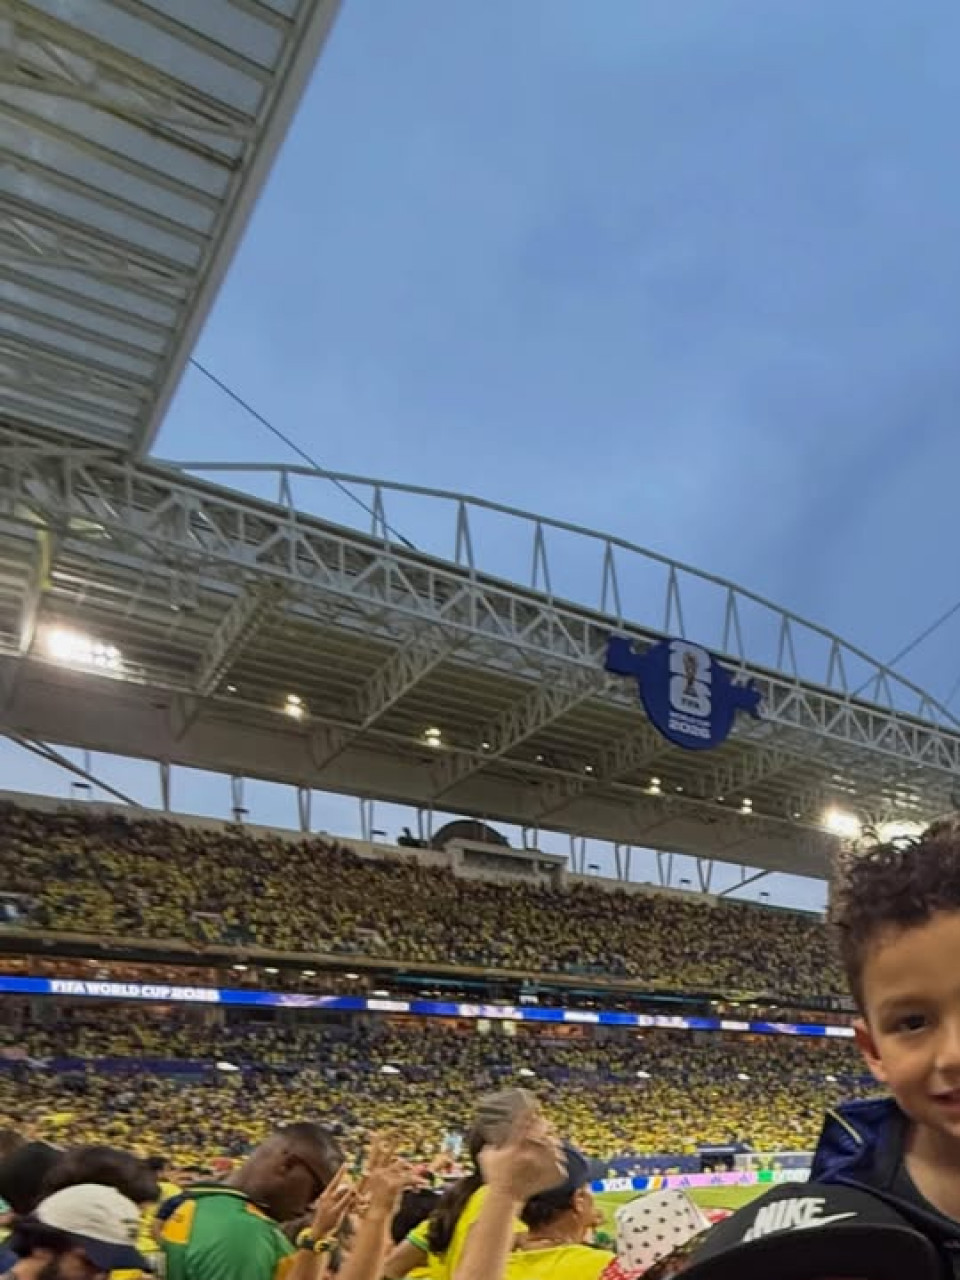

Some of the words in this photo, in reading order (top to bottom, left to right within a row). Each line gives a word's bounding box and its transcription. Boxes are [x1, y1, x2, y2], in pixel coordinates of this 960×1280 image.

[51, 979, 86, 995] FIFA
[87, 981, 140, 998] WORLD
[141, 984, 170, 999] CUP
[754, 1197, 826, 1239] NIKE
